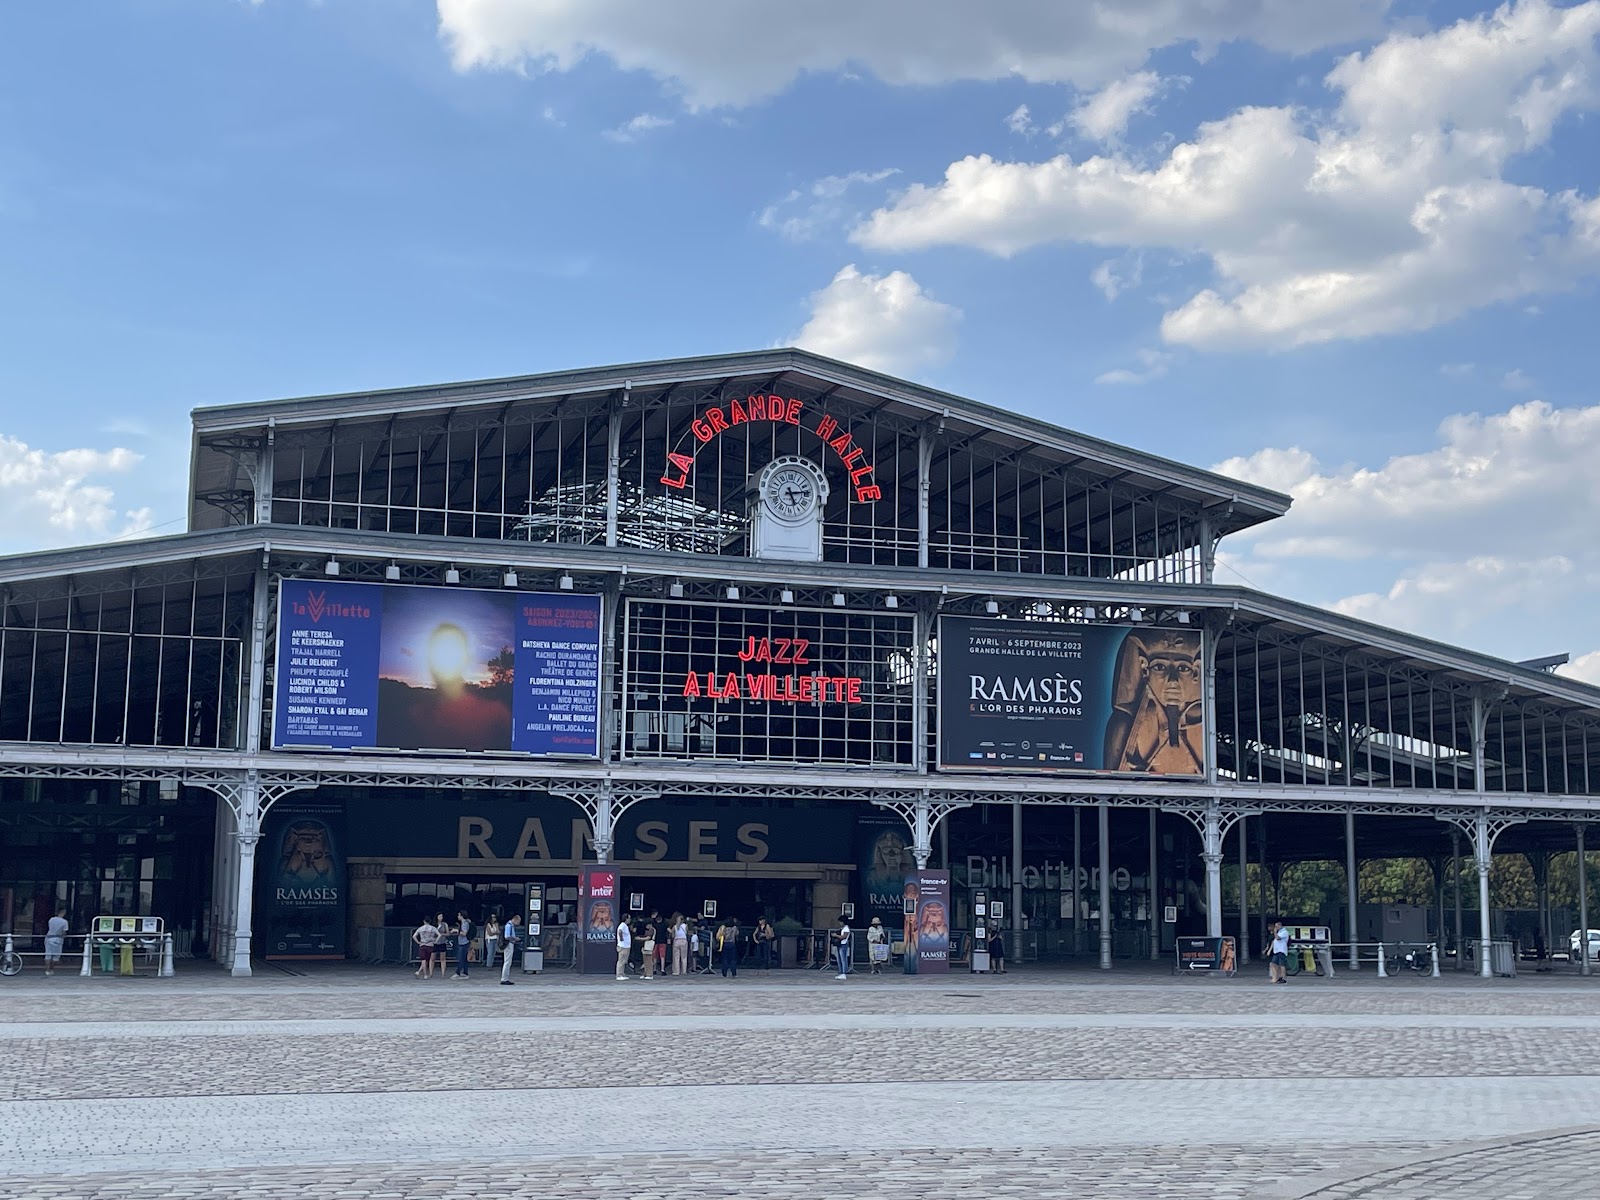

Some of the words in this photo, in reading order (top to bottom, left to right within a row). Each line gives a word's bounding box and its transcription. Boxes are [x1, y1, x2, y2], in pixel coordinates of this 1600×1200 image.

[660, 451, 694, 489] LA
[691, 394, 804, 443] GRANDE
[815, 414, 882, 503] HALLE
[292, 630, 308, 638] ANNE
[310, 630, 333, 638] TERESA
[301, 638, 344, 647] KEERSMAEKER
[522, 640, 550, 649] BATSHEVA
[552, 642, 570, 650] DANCE
[572, 643, 598, 651] COMPANY
[976, 638, 999, 646] AVRIL
[1014, 640, 1061, 648] SEPTEMBRE
[1063, 642, 1082, 650] 2023
[291, 648, 313, 656] TRAJAL
[315, 648, 341, 657] HARRELL
[738, 635, 810, 664] JAZZ
[1001, 648, 1024, 656] HALLE
[1048, 651, 1081, 659] VILLETTE
[309, 658, 338, 667] DELIQUET
[578, 661, 597, 669] GRAND
[290, 668, 317, 676] PHILIPPE
[319, 668, 349, 677] DECOUFLÉ
[289, 678, 315, 686] LUCINDA
[317, 679, 339, 687] CHILDS
[530, 678, 564, 686] FLORENTINA
[565, 679, 596, 687] HOLZINGER
[683, 670, 700, 697] A
[707, 672, 741, 699] LA
[747, 673, 862, 704] VILLETTE
[289, 686, 313, 694] ROBERT
[969, 672, 1082, 704] RAMSÈS
[562, 689, 590, 697] MILLEPIED
[288, 696, 317, 704] SUSANNE
[319, 697, 347, 705] KENNEDY
[288, 706, 313, 714] SHARON
[330, 707, 335, 715] &
[336, 707, 346, 715] GAI
[348, 708, 368, 716] BEHAR
[970, 703, 975, 711] &
[980, 704, 1002, 712] L'OR
[1006, 705, 1024, 713] DES
[1029, 705, 1082, 716] PHARAONS
[288, 716, 318, 724] BARTABAS
[573, 714, 595, 722] BUREAU
[527, 723, 551, 731] ANGELIN
[276, 885, 338, 900] RAMSÈS
[592, 886, 613, 896] inter
